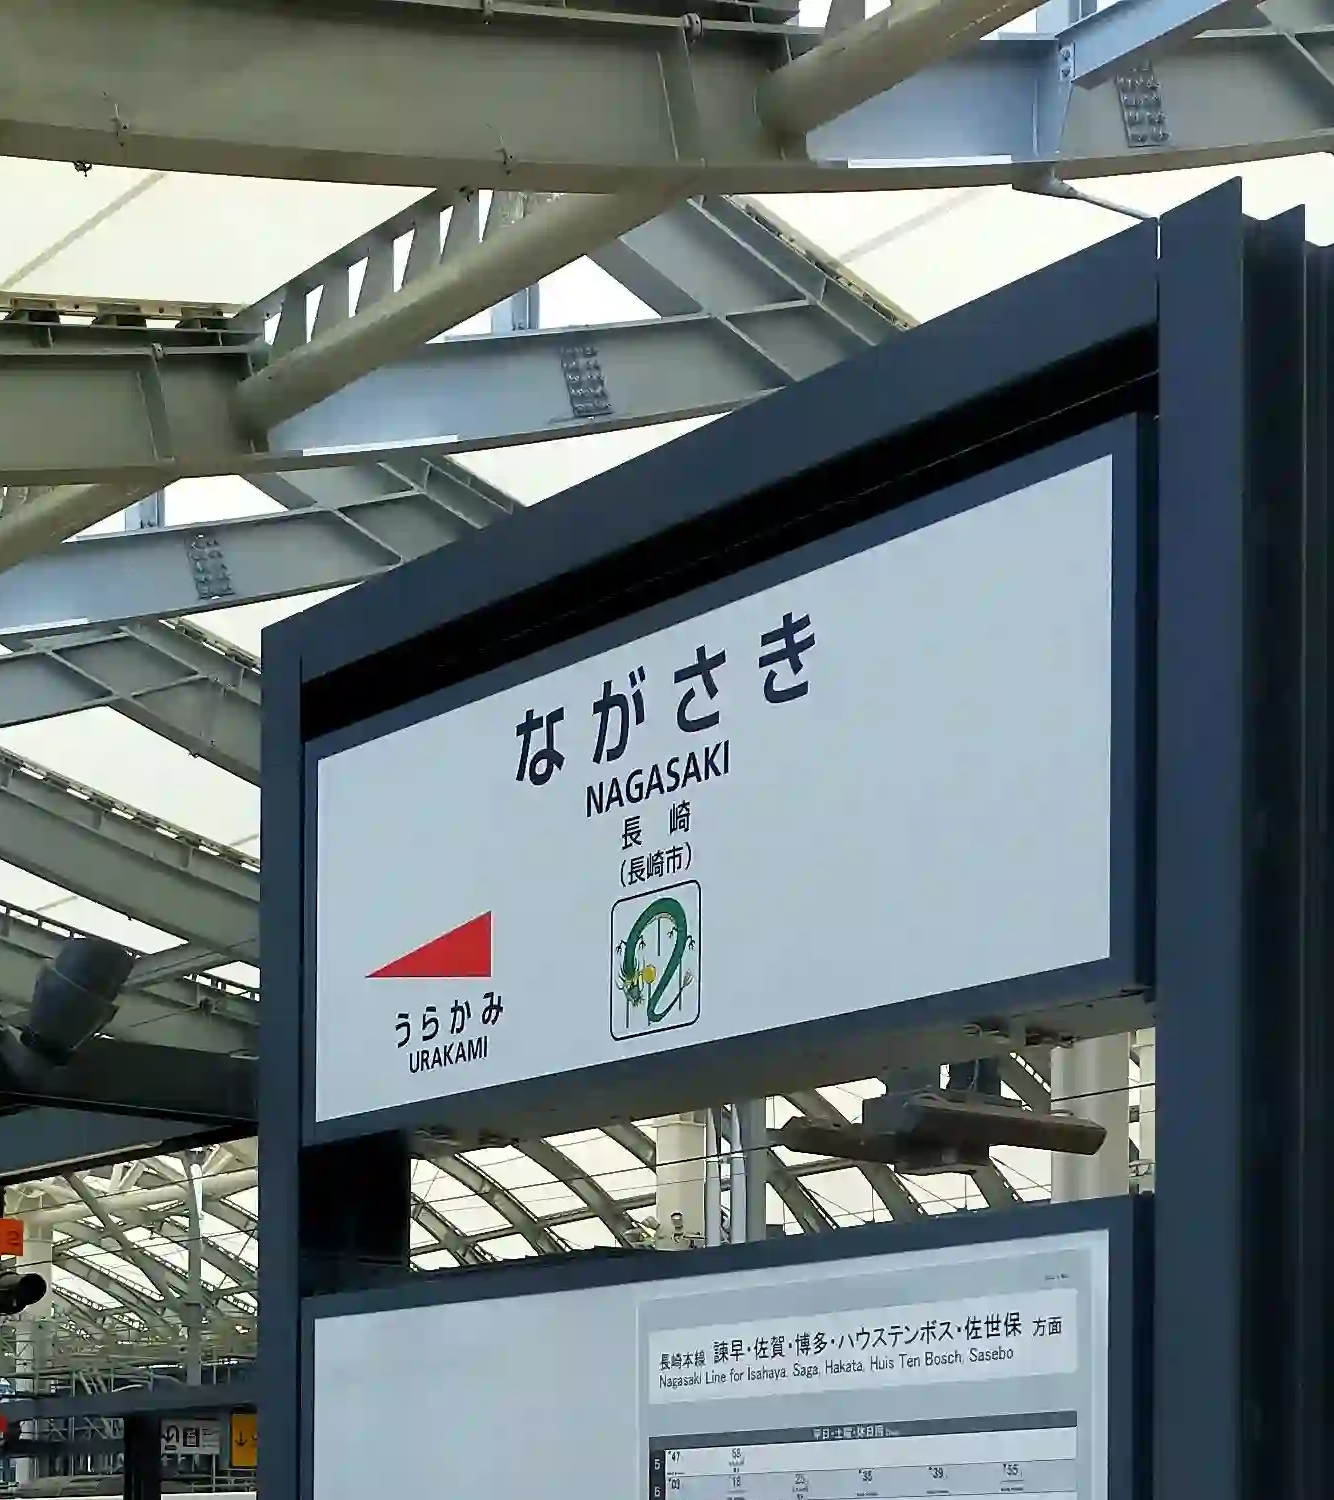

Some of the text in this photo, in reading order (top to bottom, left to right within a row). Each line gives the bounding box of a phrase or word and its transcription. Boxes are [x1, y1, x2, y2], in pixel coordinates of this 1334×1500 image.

[514, 611, 817, 787] ながさき
[585, 740, 731, 818] NAGASAKI
[620, 799, 692, 851] 長崎
[618, 843, 693, 889] (長崎市)
[394, 990, 505, 1049] うらかみ
[408, 1035, 489, 1075] URAKAMI
[659, 1350, 707, 1371] 長崎本線
[1032, 1316, 1063, 1338] 方面
[659, 1371, 702, 1389] Nagasaki
[705, 1370, 726, 1384] Line
[729, 1368, 743, 1382] for
[870, 1355, 895, 1371] Huis
[899, 1353, 920, 1369] Ten
[969, 1346, 1014, 1363] Sasebo
[654, 1459, 661, 1470] 5
[654, 1486, 661, 1497] 6
